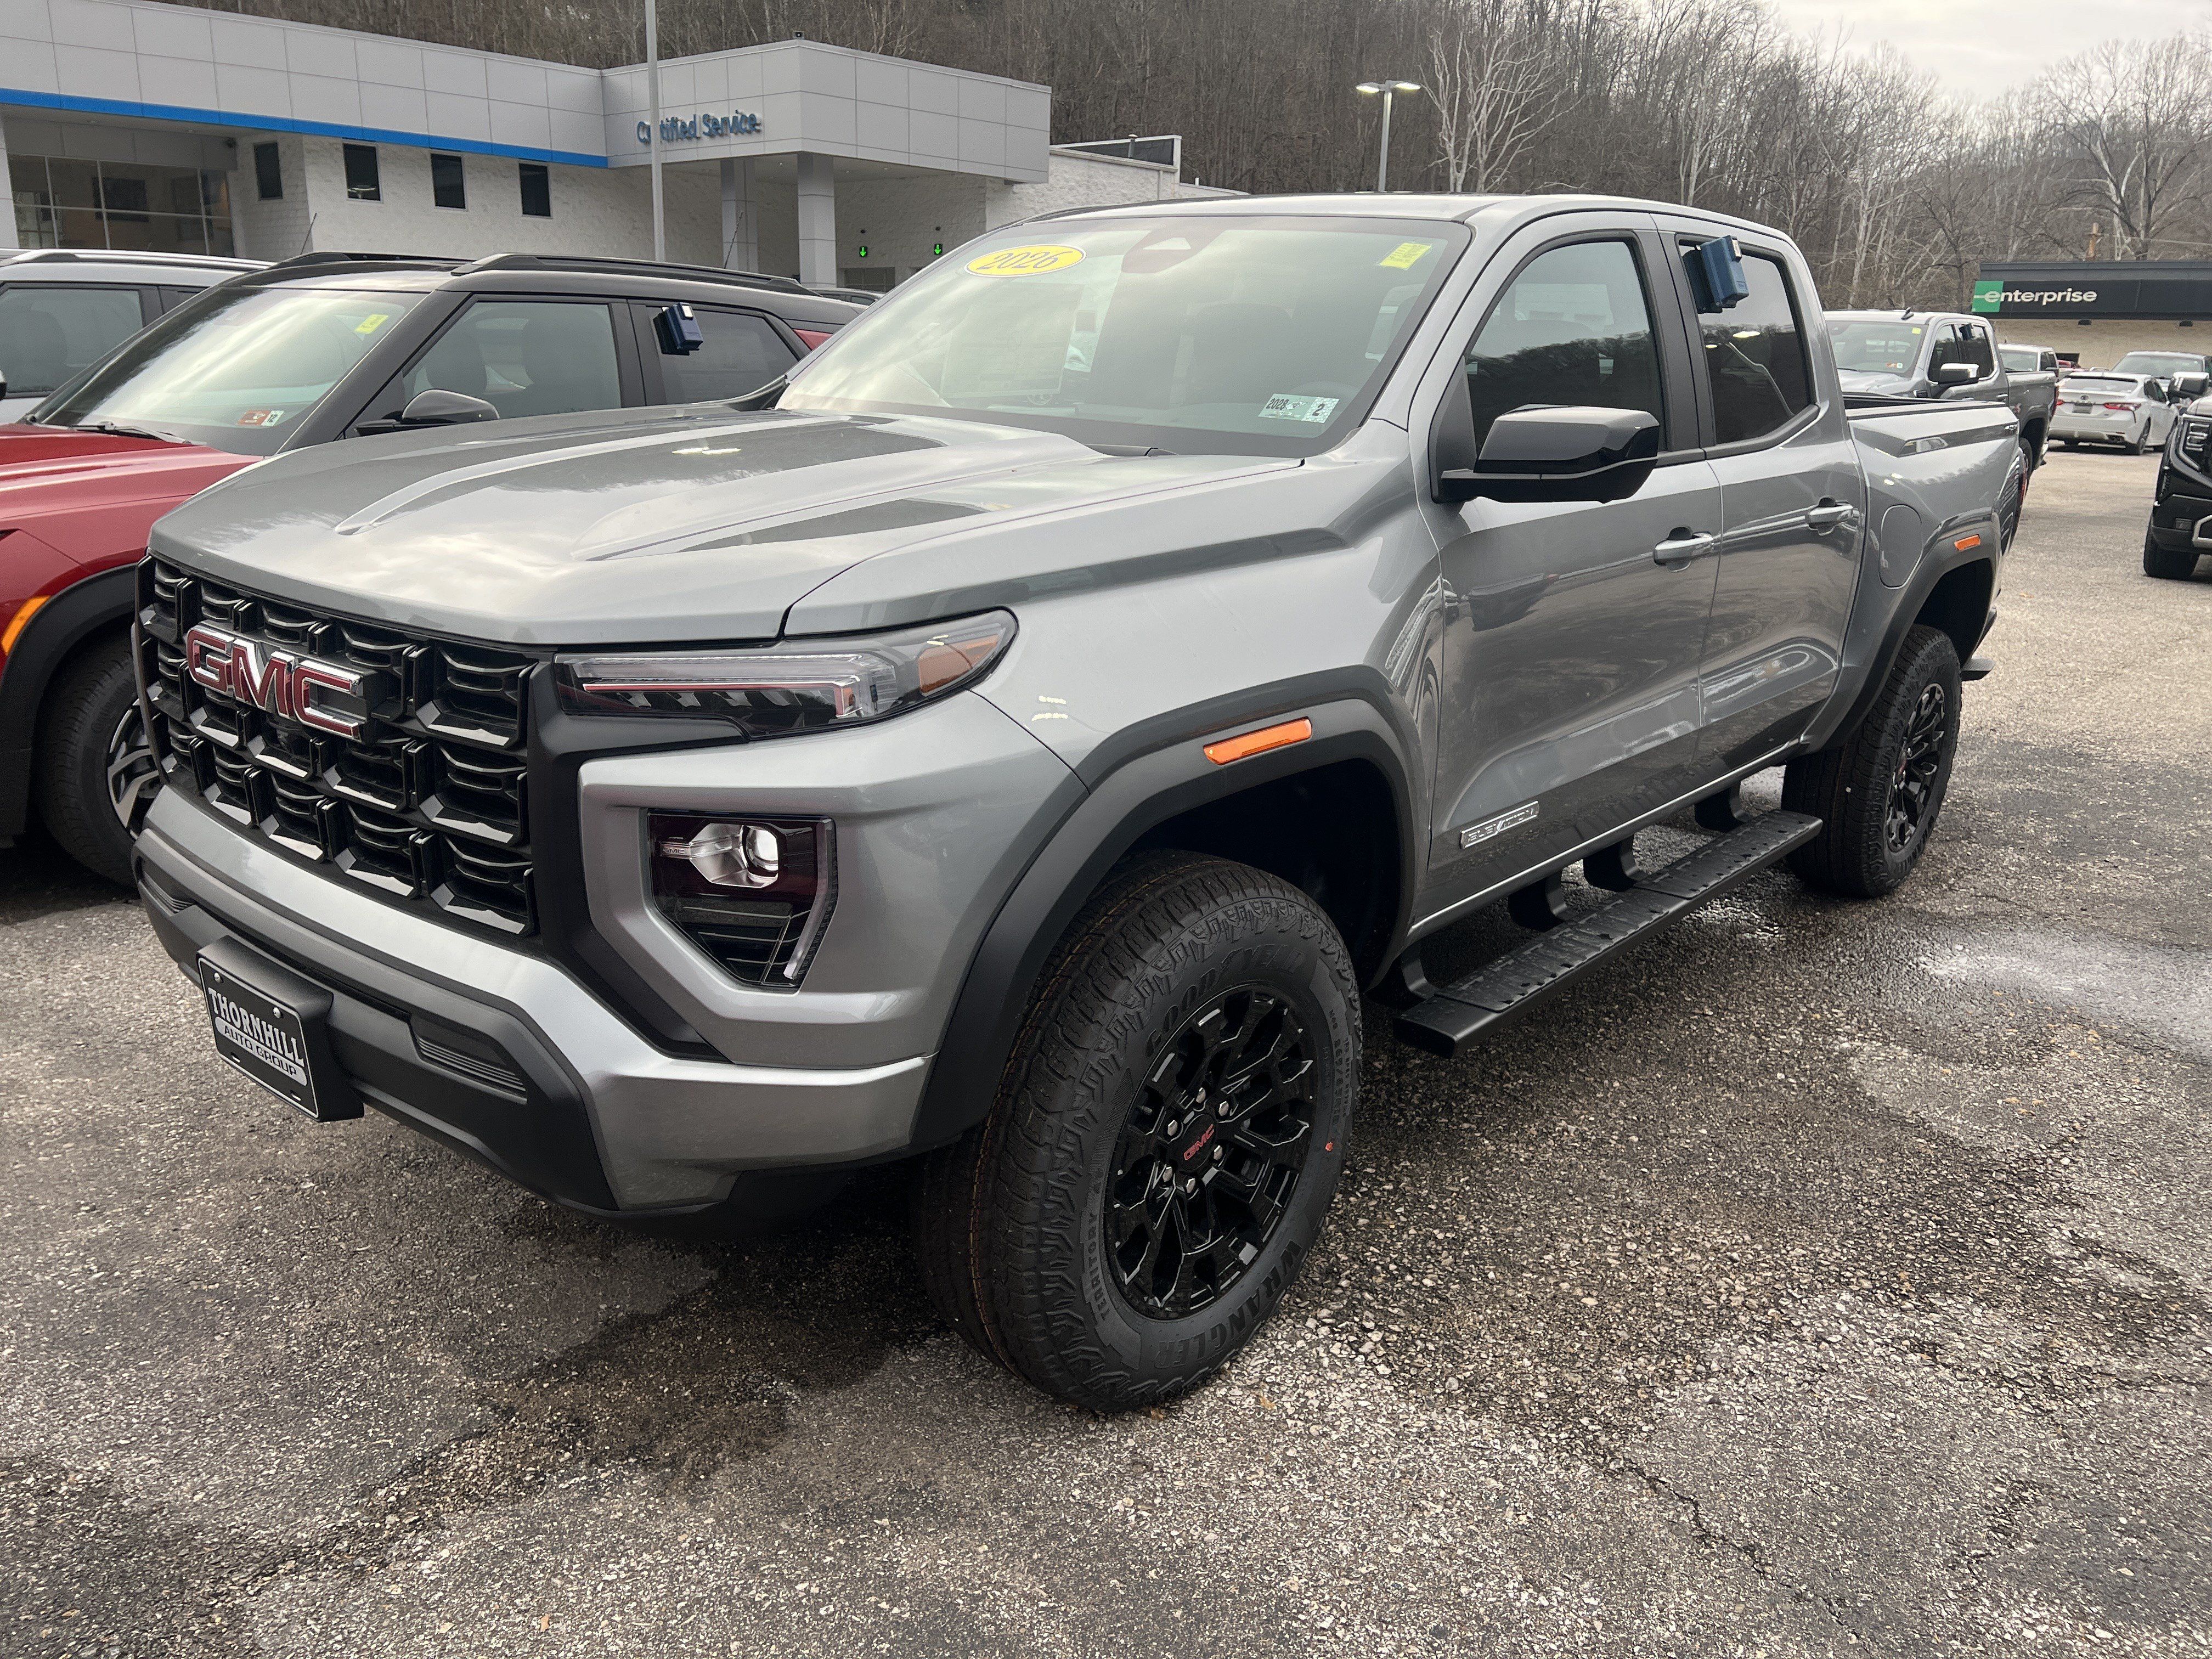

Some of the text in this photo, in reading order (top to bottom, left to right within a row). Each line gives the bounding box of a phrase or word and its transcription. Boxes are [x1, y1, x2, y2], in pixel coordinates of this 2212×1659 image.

[702, 110, 758, 137] Service
[976, 251, 1073, 269] 2026
[1984, 288, 2097, 306] enterprise
[1266, 398, 1289, 410] 2028
[1312, 403, 1325, 416] 2
[186, 620, 364, 741] GMC
[207, 987, 304, 1068] THORNHILL
[224, 1025, 297, 1076] AUTO GROUP
[1183, 1124, 1215, 1161] GMC
[1087, 1212, 1110, 1322] TERRITORY
[1154, 1238, 1304, 1369] WRANGLER
